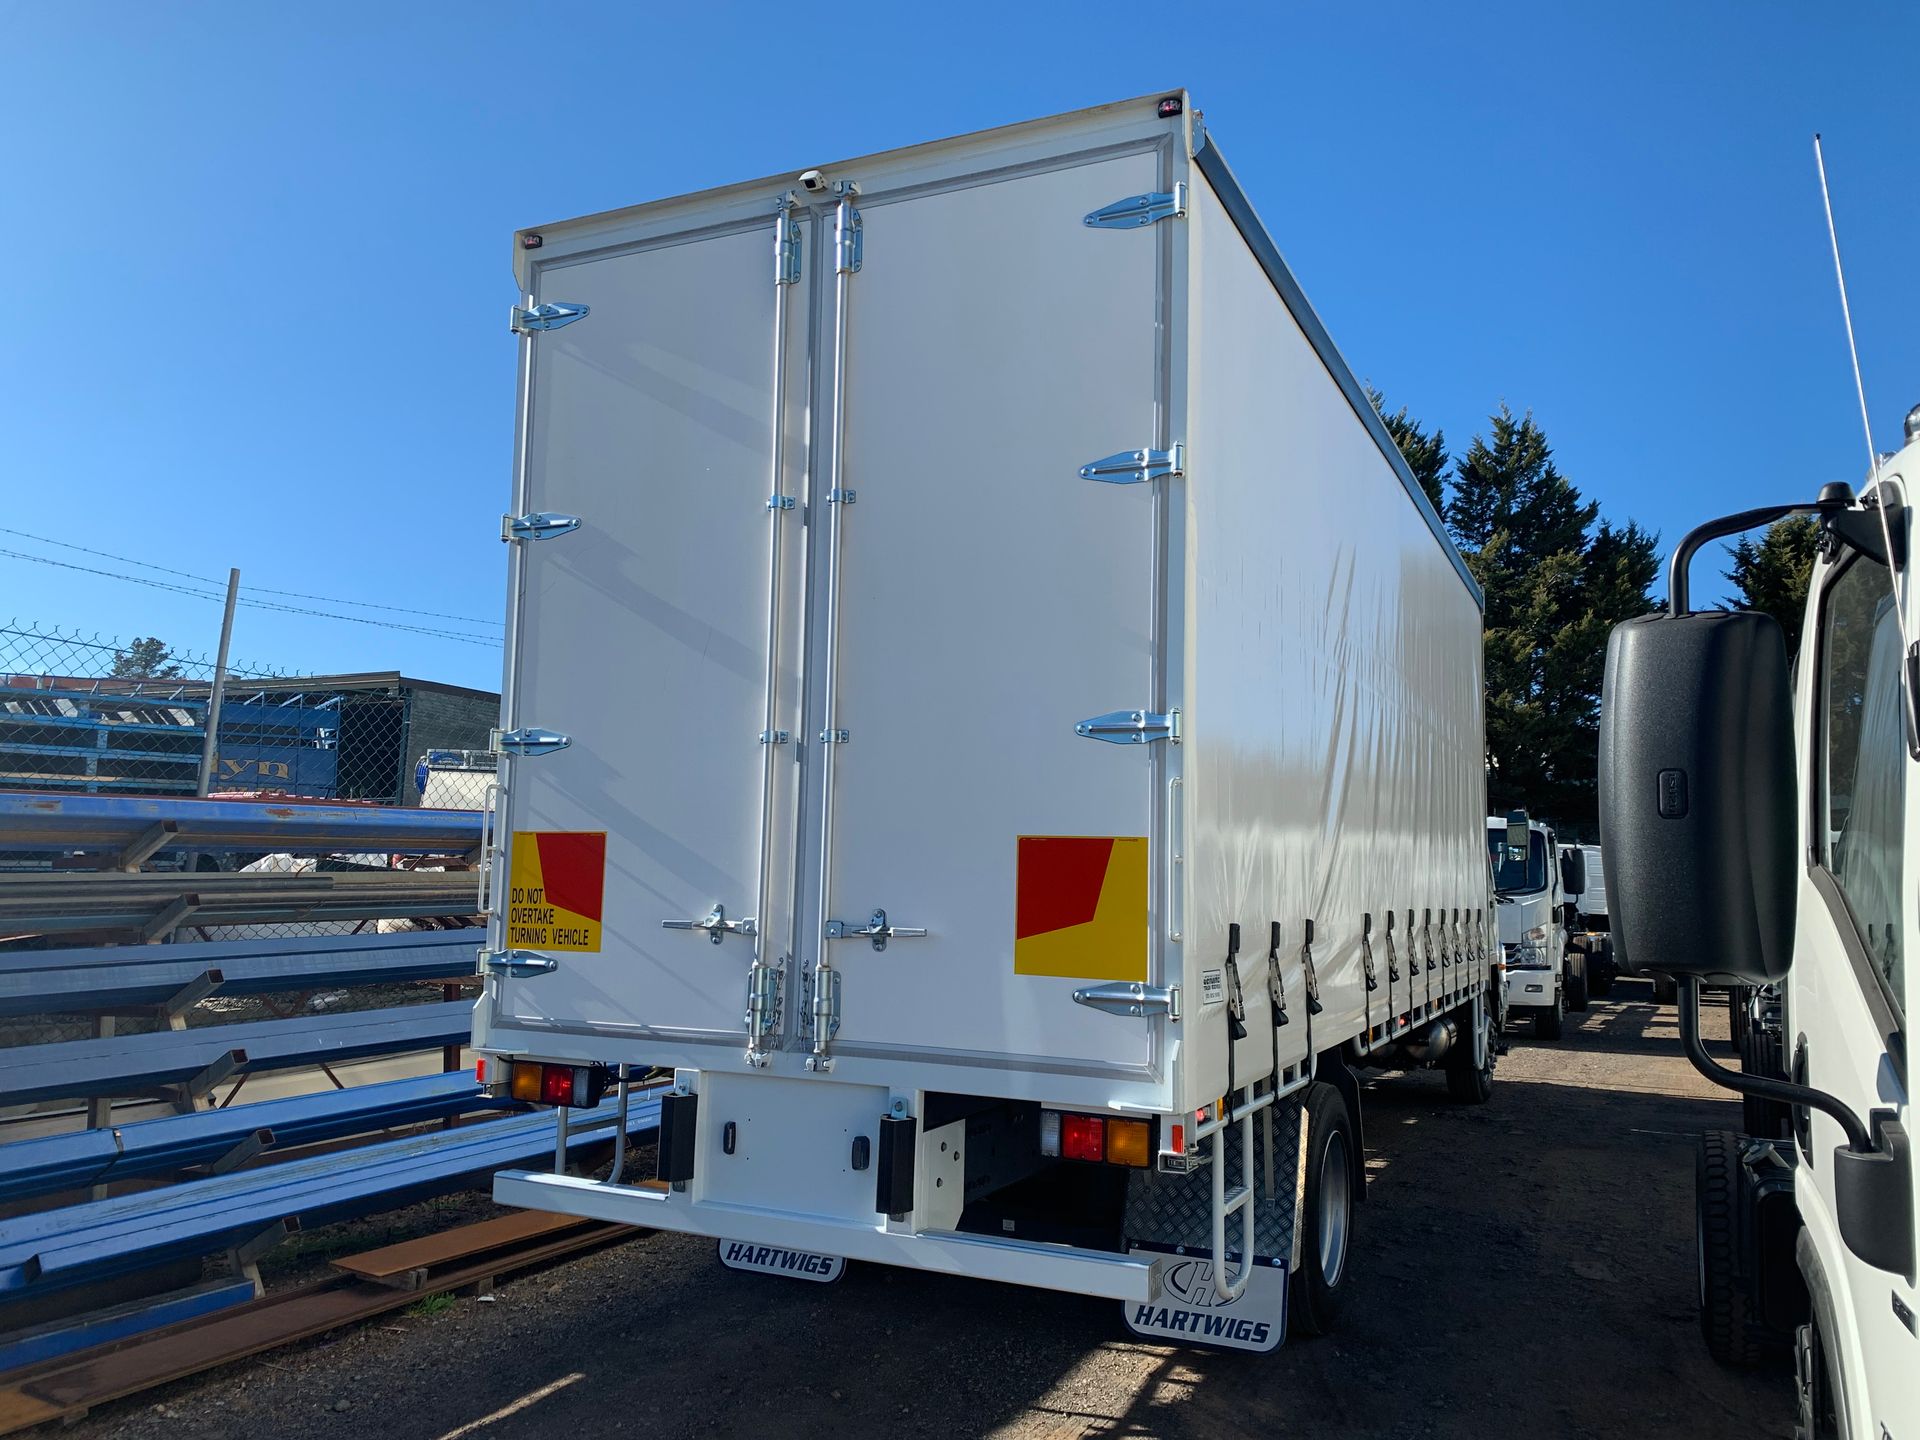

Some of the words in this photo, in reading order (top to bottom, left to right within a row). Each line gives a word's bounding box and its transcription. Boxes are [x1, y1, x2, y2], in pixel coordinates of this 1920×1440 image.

[512, 888, 524, 904] DO
[527, 888, 543, 904] NOT
[511, 908, 554, 924] OVERTAKE
[510, 927, 547, 944] TURNING
[552, 929, 589, 945] VEHICLE
[726, 1243, 833, 1275] HARTWIGS
[1134, 1304, 1270, 1343] HARTWIGS
